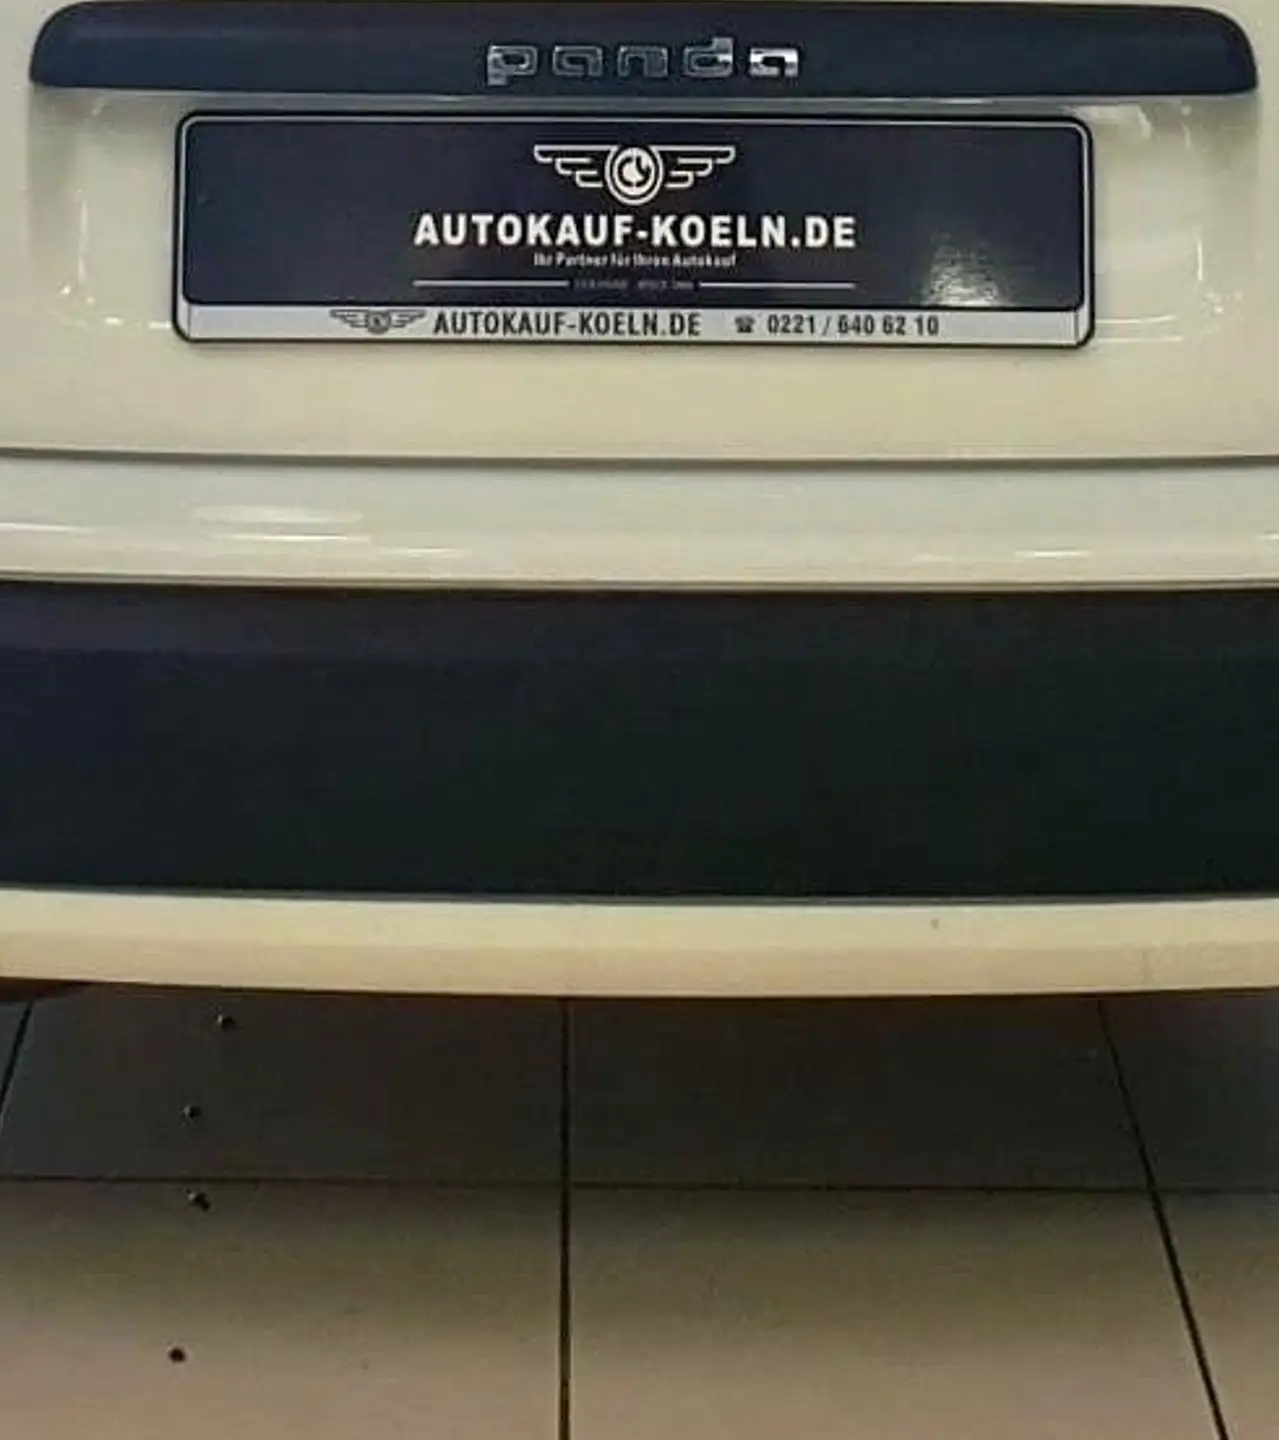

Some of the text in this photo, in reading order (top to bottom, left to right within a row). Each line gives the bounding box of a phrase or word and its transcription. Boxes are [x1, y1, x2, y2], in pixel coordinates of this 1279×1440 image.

[487, 37, 800, 86] panda
[413, 213, 857, 248] AUTOKAUF-KOELN.DE
[533, 252, 553, 266] Ihr
[556, 252, 607, 266] Partner
[672, 250, 736, 268] Autokauf
[433, 311, 939, 336] AUTOKAUF-KOELN.DE 0221 / 640 62 10
